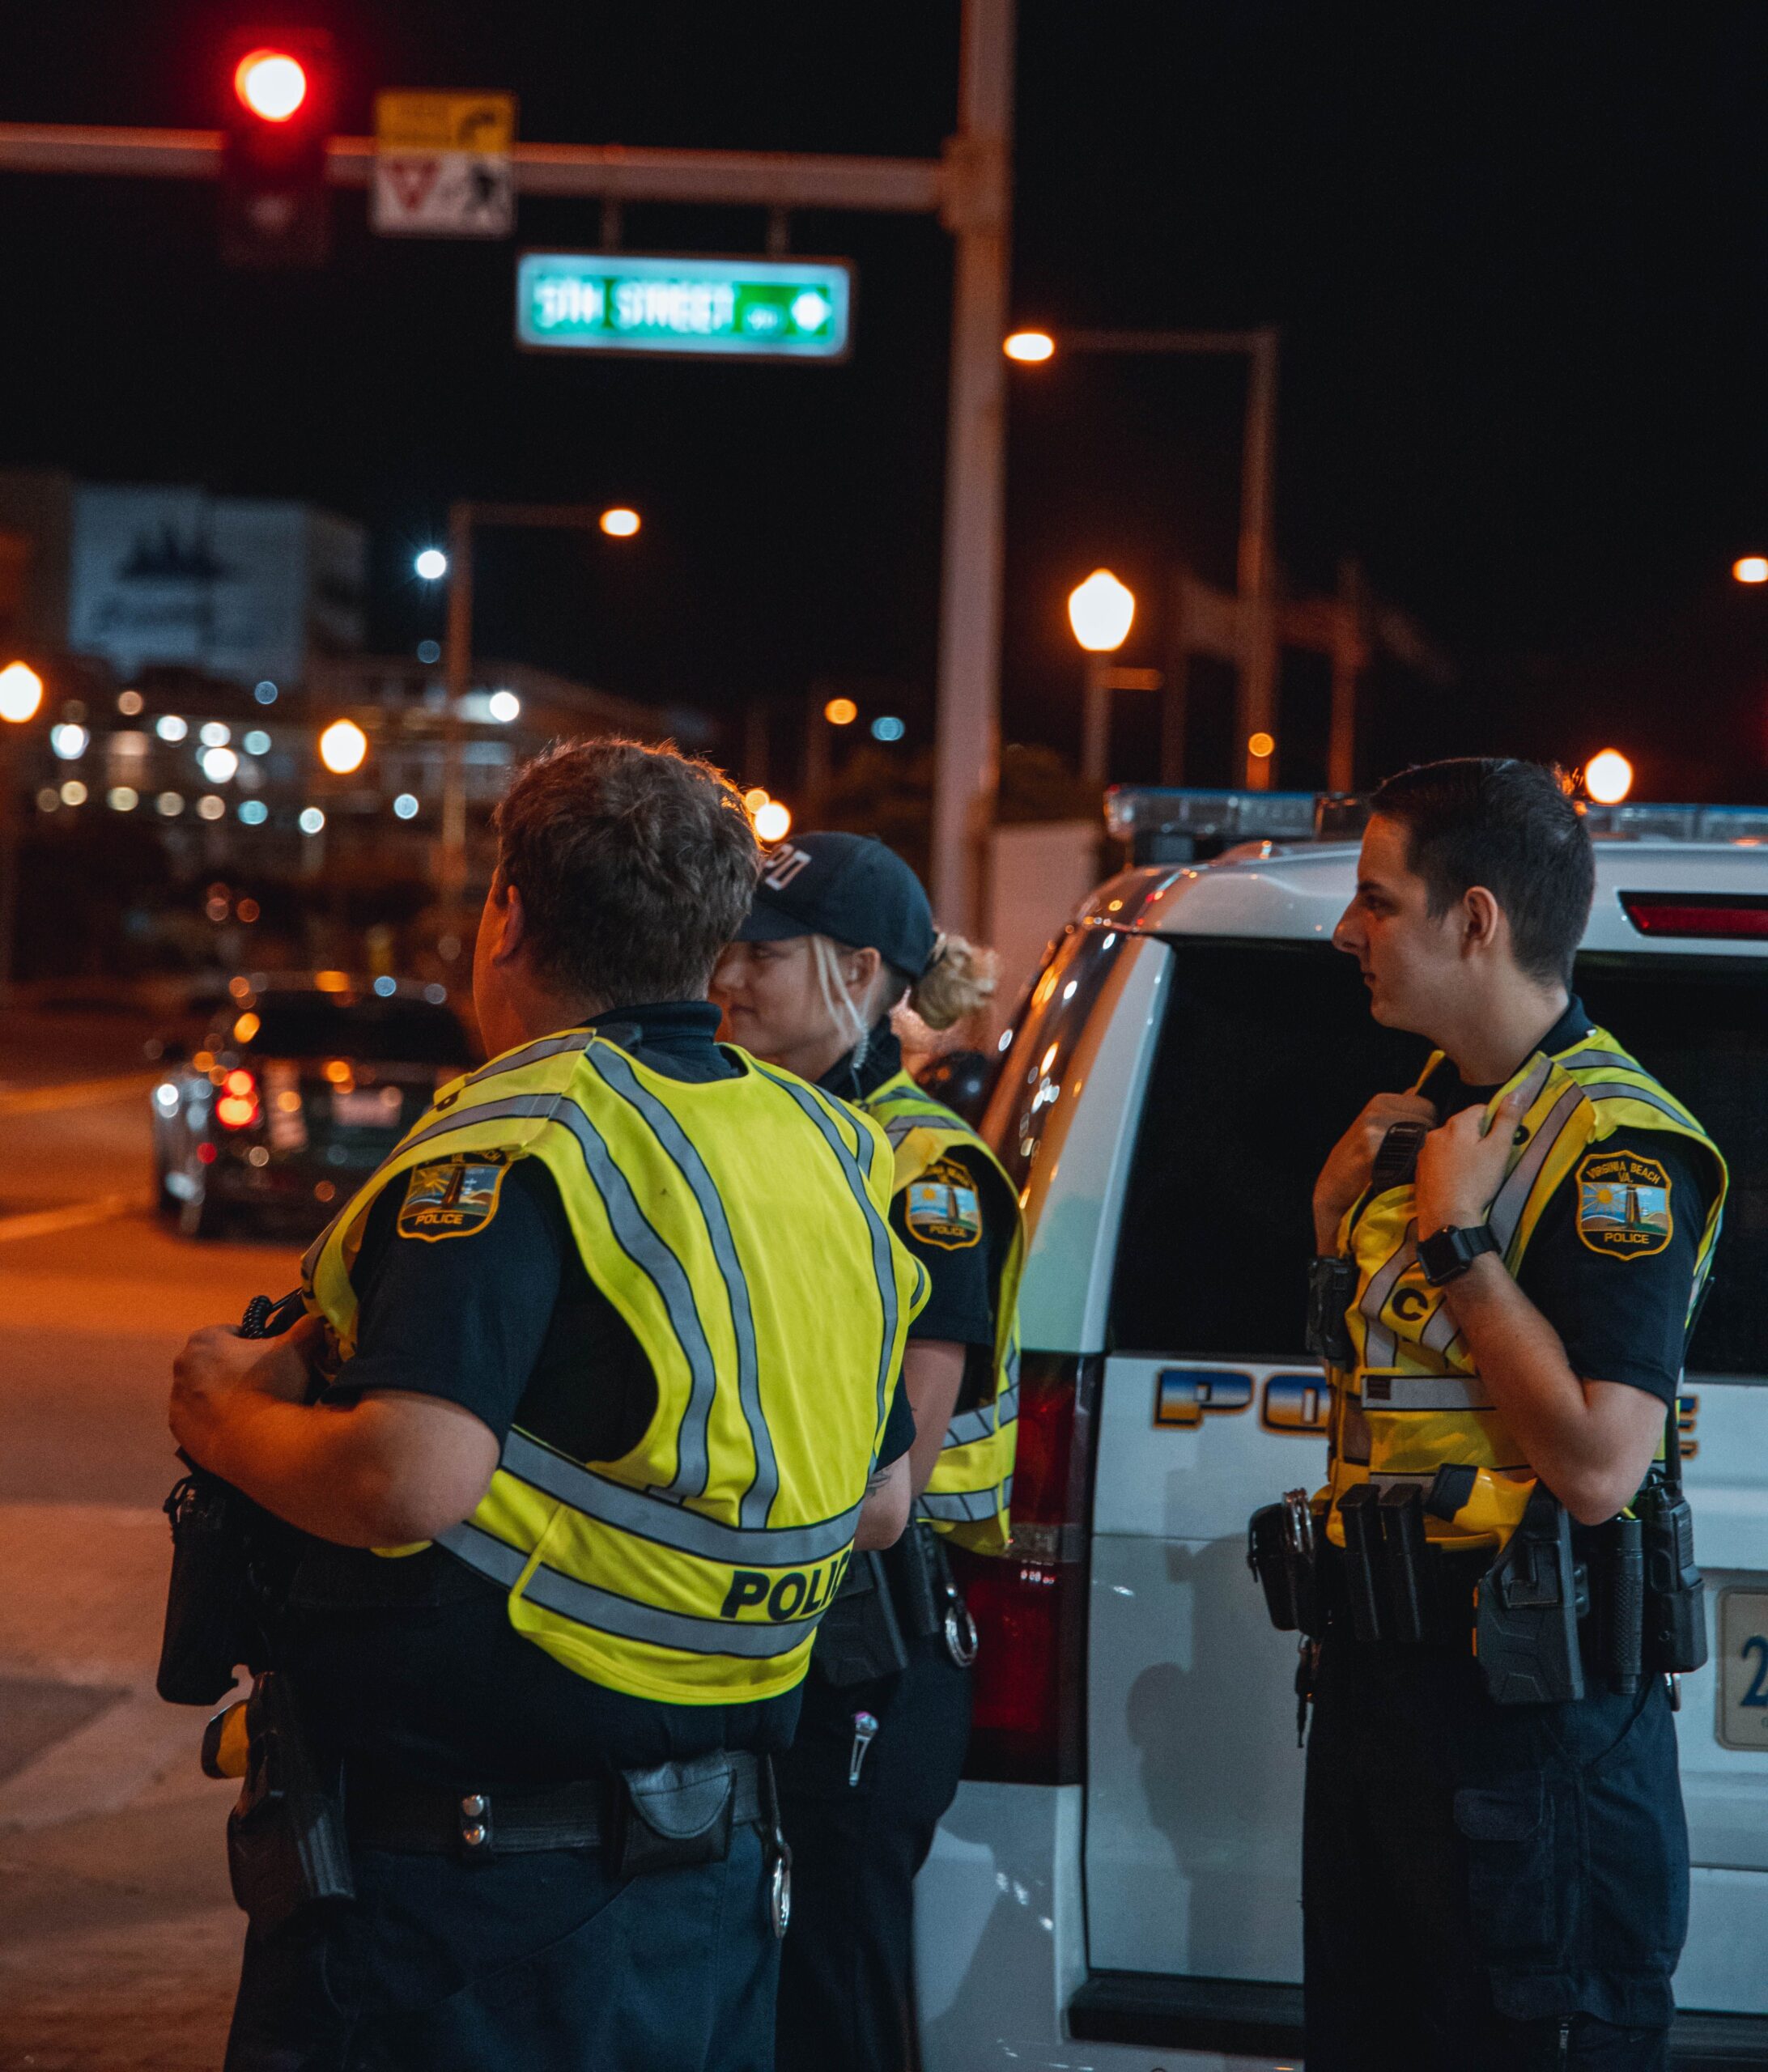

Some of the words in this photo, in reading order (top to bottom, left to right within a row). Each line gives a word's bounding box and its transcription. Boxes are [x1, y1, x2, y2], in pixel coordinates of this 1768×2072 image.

[1586, 1161, 1627, 1179] VIRGINIA
[1630, 1162, 1661, 1185] BEACH
[414, 1214, 465, 1225] POLICE
[1604, 1232, 1650, 1244] POLICE
